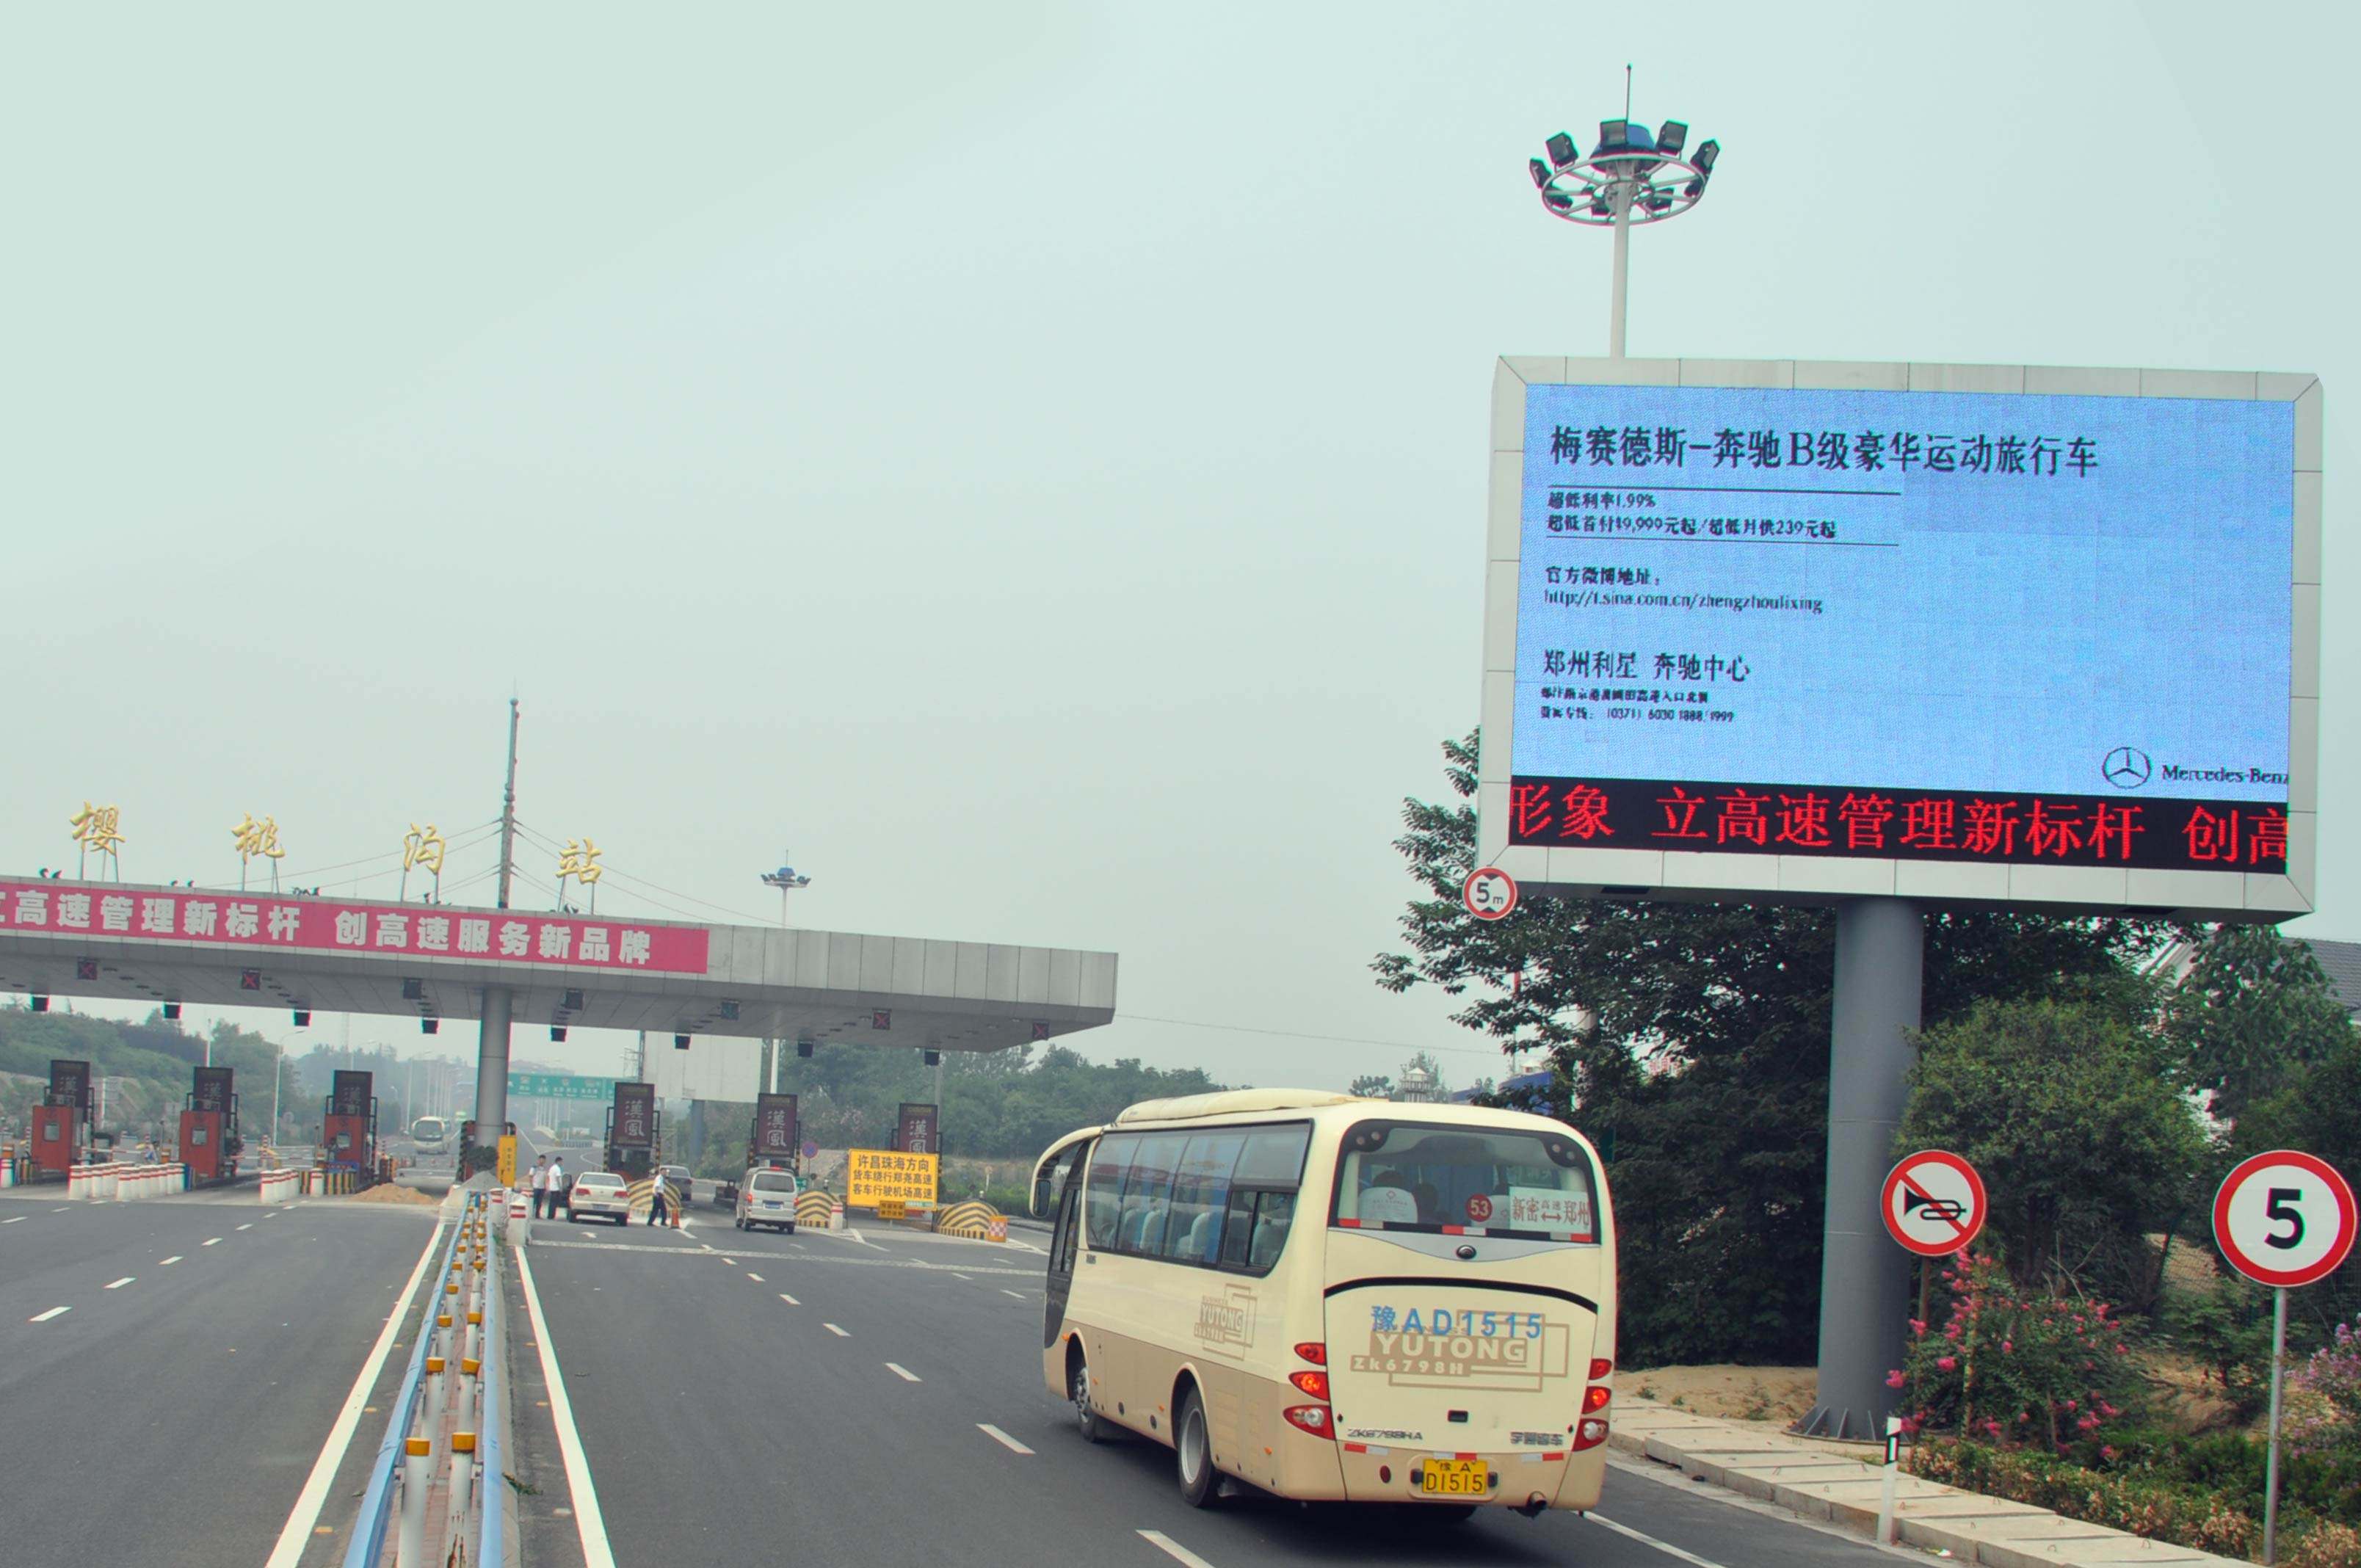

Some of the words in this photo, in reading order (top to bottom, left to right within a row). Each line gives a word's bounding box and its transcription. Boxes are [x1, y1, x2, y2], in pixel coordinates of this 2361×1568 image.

[1543, 649, 1638, 678] 郑州利星
[1654, 652, 1751, 683] 奔驰中心
[1511, 783, 1615, 840] 形象
[1650, 785, 2145, 860] 立高速管理新标杆
[2182, 805, 2289, 865] 创高
[1476, 882, 1504, 905] 5m
[0, 890, 301, 942] 高速管理新标杆
[335, 910, 651, 965] 创高速服务新品牌
[857, 1154, 929, 1172] 许昌珠海方向
[853, 1183, 933, 1199] 客车行驶机场高速
[1470, 1199, 1489, 1217] 53
[1512, 1197, 1539, 1222] 新密
[1564, 1200, 1591, 1227] 郑州
[2263, 1186, 2306, 1250] 5
[1370, 1304, 1542, 1340] 豫AD1515
[1375, 1333, 1526, 1363] YUTONG
[1425, 1473, 1484, 1492] D1515
